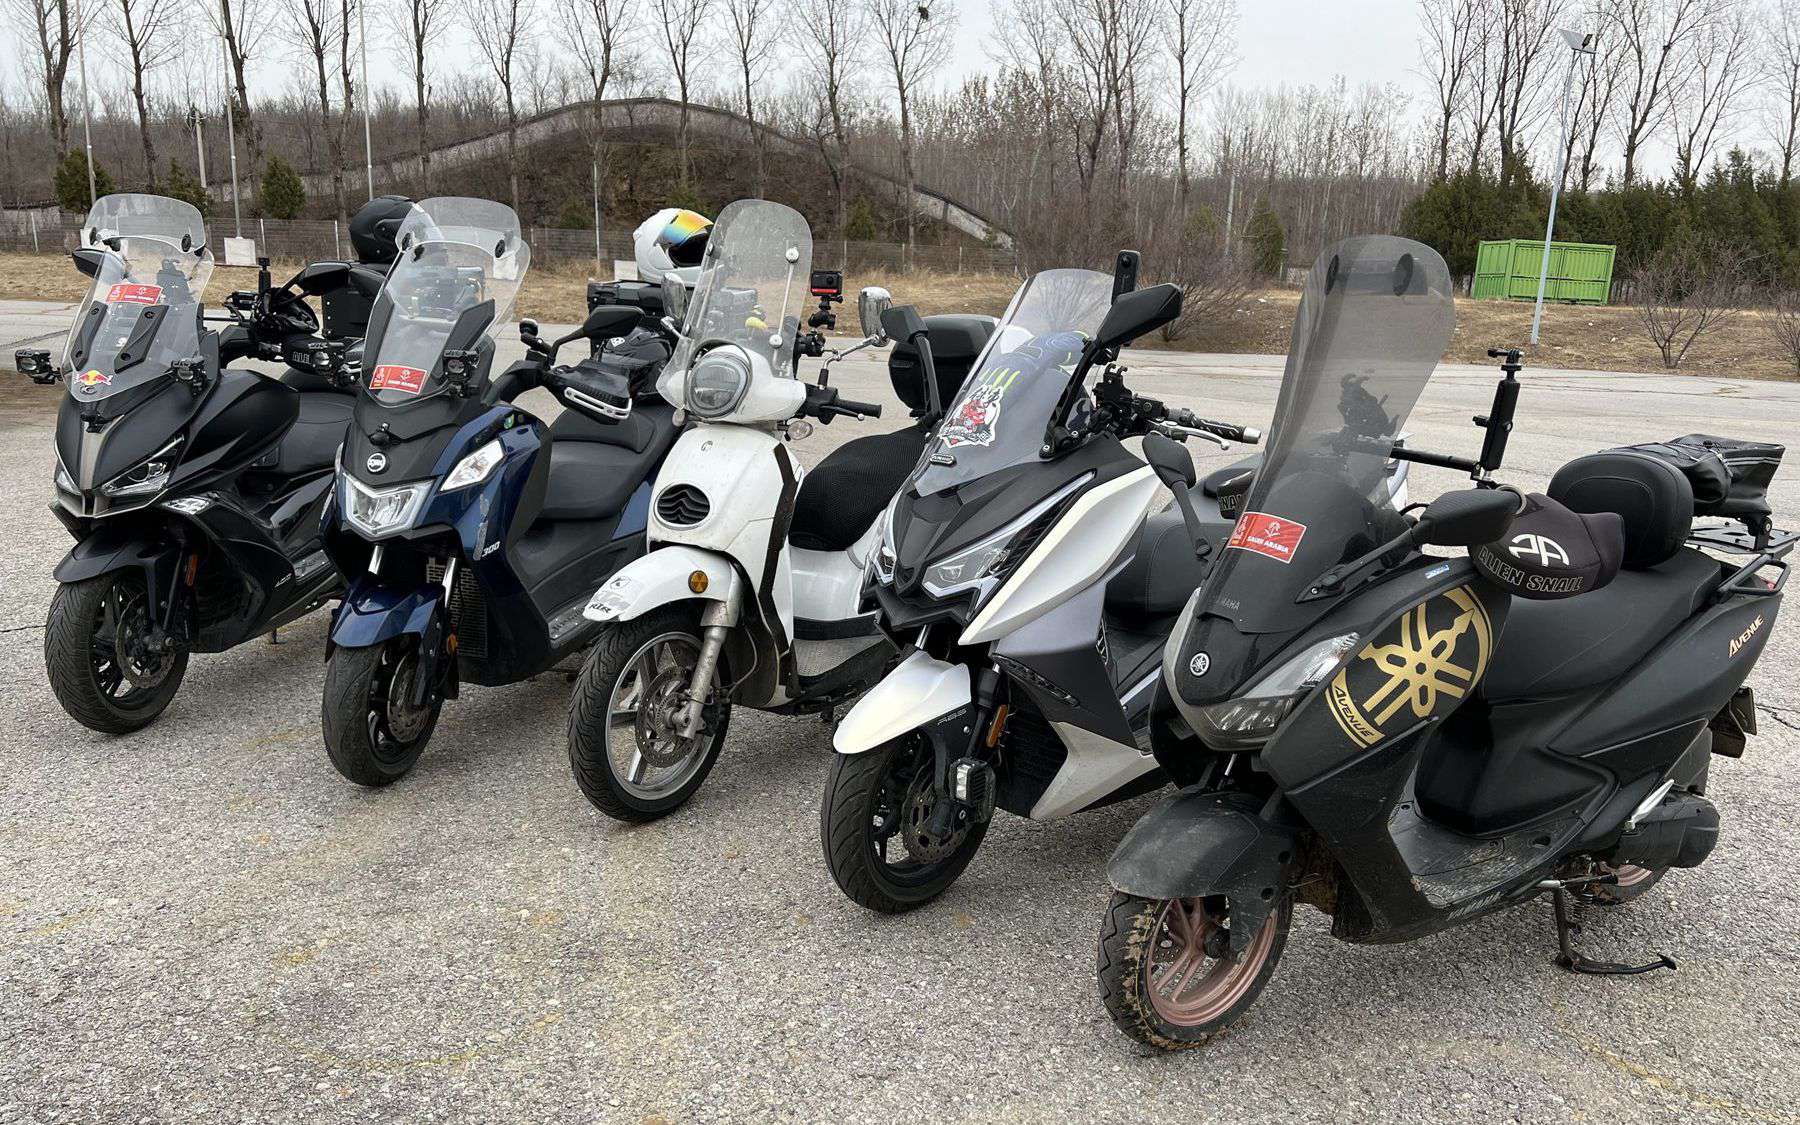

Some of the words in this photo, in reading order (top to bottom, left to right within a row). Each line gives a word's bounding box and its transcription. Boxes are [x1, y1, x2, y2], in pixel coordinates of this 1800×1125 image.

[481, 541, 500, 557] 300
[1264, 540, 1289, 553] ARABIA
[1478, 545, 1525, 586] ALIEN
[1526, 574, 1584, 593] SNAIL
[1729, 614, 1764, 659] AVENUE
[1334, 686, 1375, 737] AVENUE
